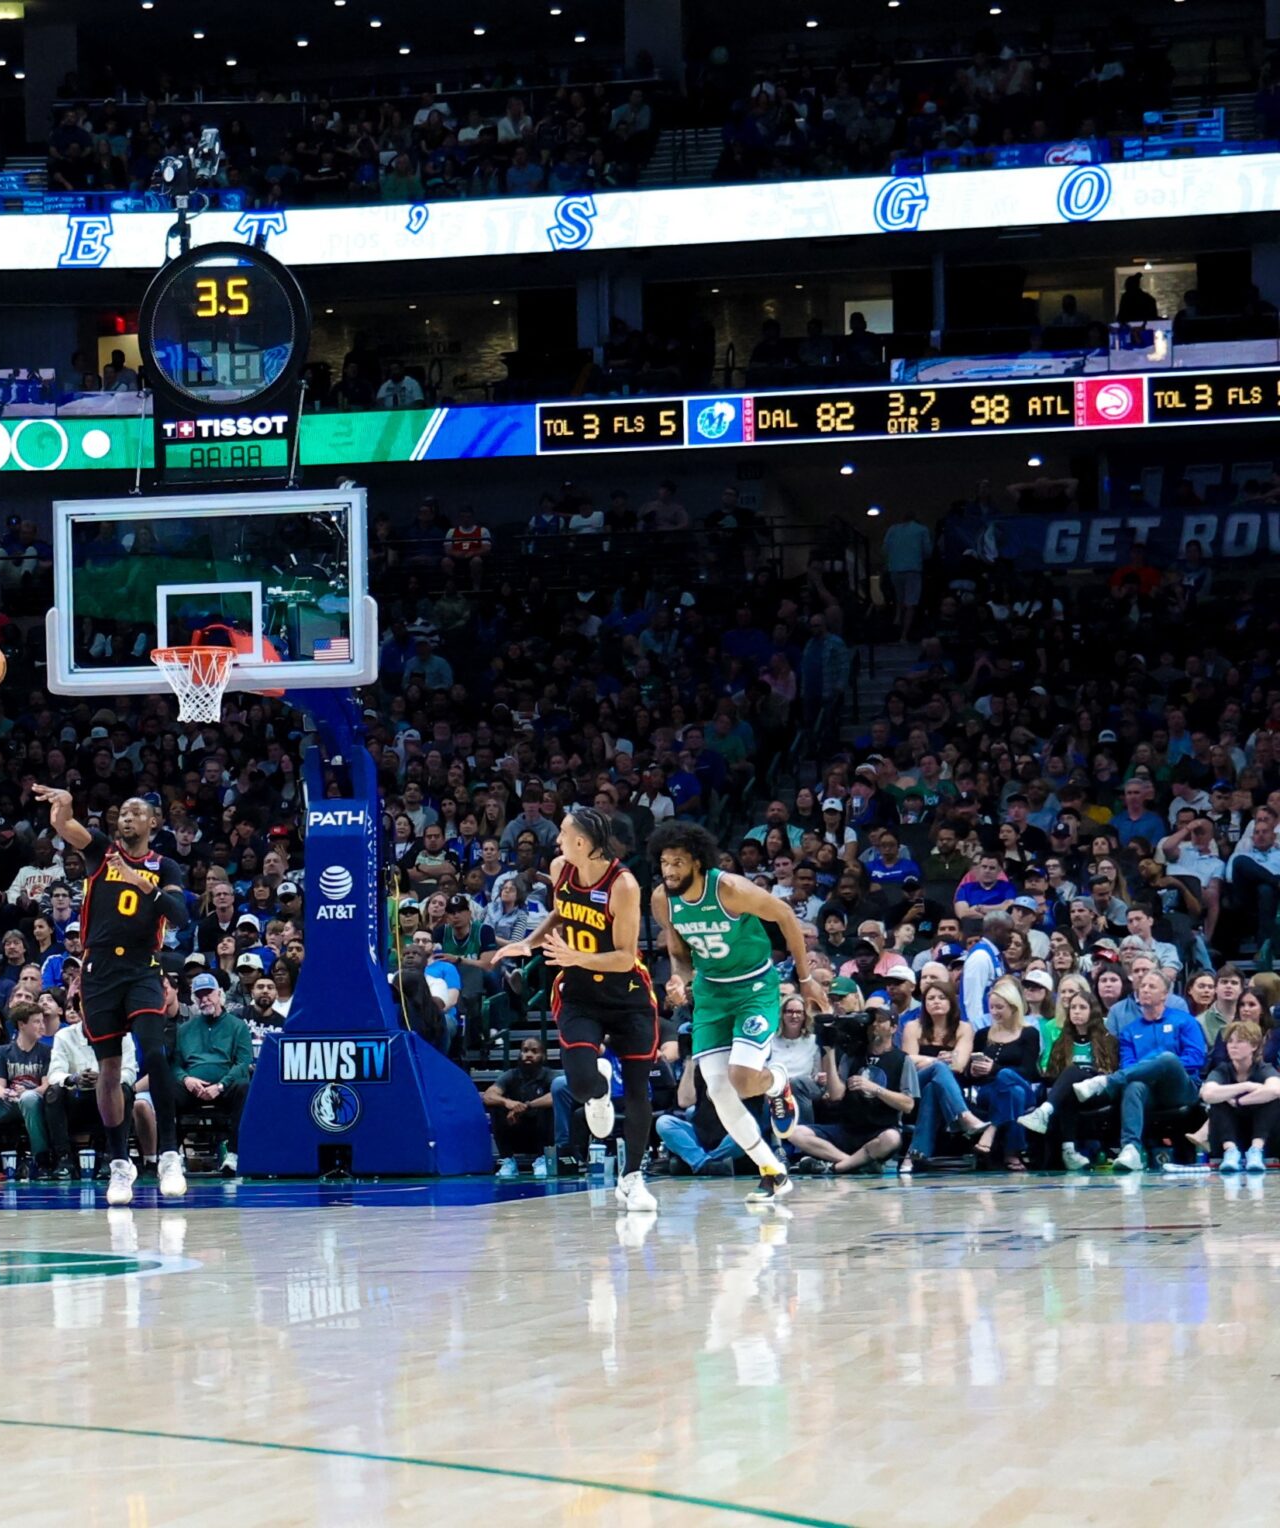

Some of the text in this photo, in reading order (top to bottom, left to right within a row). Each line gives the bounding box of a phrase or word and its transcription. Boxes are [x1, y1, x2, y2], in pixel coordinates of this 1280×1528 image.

[195, 277, 250, 318] 3.5
[887, 391, 937, 416] 3.7
[970, 394, 1070, 426] 98 ATL
[1153, 390, 1188, 409] TOL
[1194, 383, 1213, 411] 3
[1227, 386, 1263, 406] FLS
[197, 415, 288, 438] TISSOT
[543, 410, 676, 439] TOL 3 FLS 5
[758, 402, 855, 432] DAL 82
[887, 417, 941, 434] QTR 3
[1041, 515, 1163, 564] GET
[309, 810, 364, 827] PATH
[117, 889, 139, 916] 0
[316, 905, 357, 920] AT&T
[565, 924, 598, 954] 10
